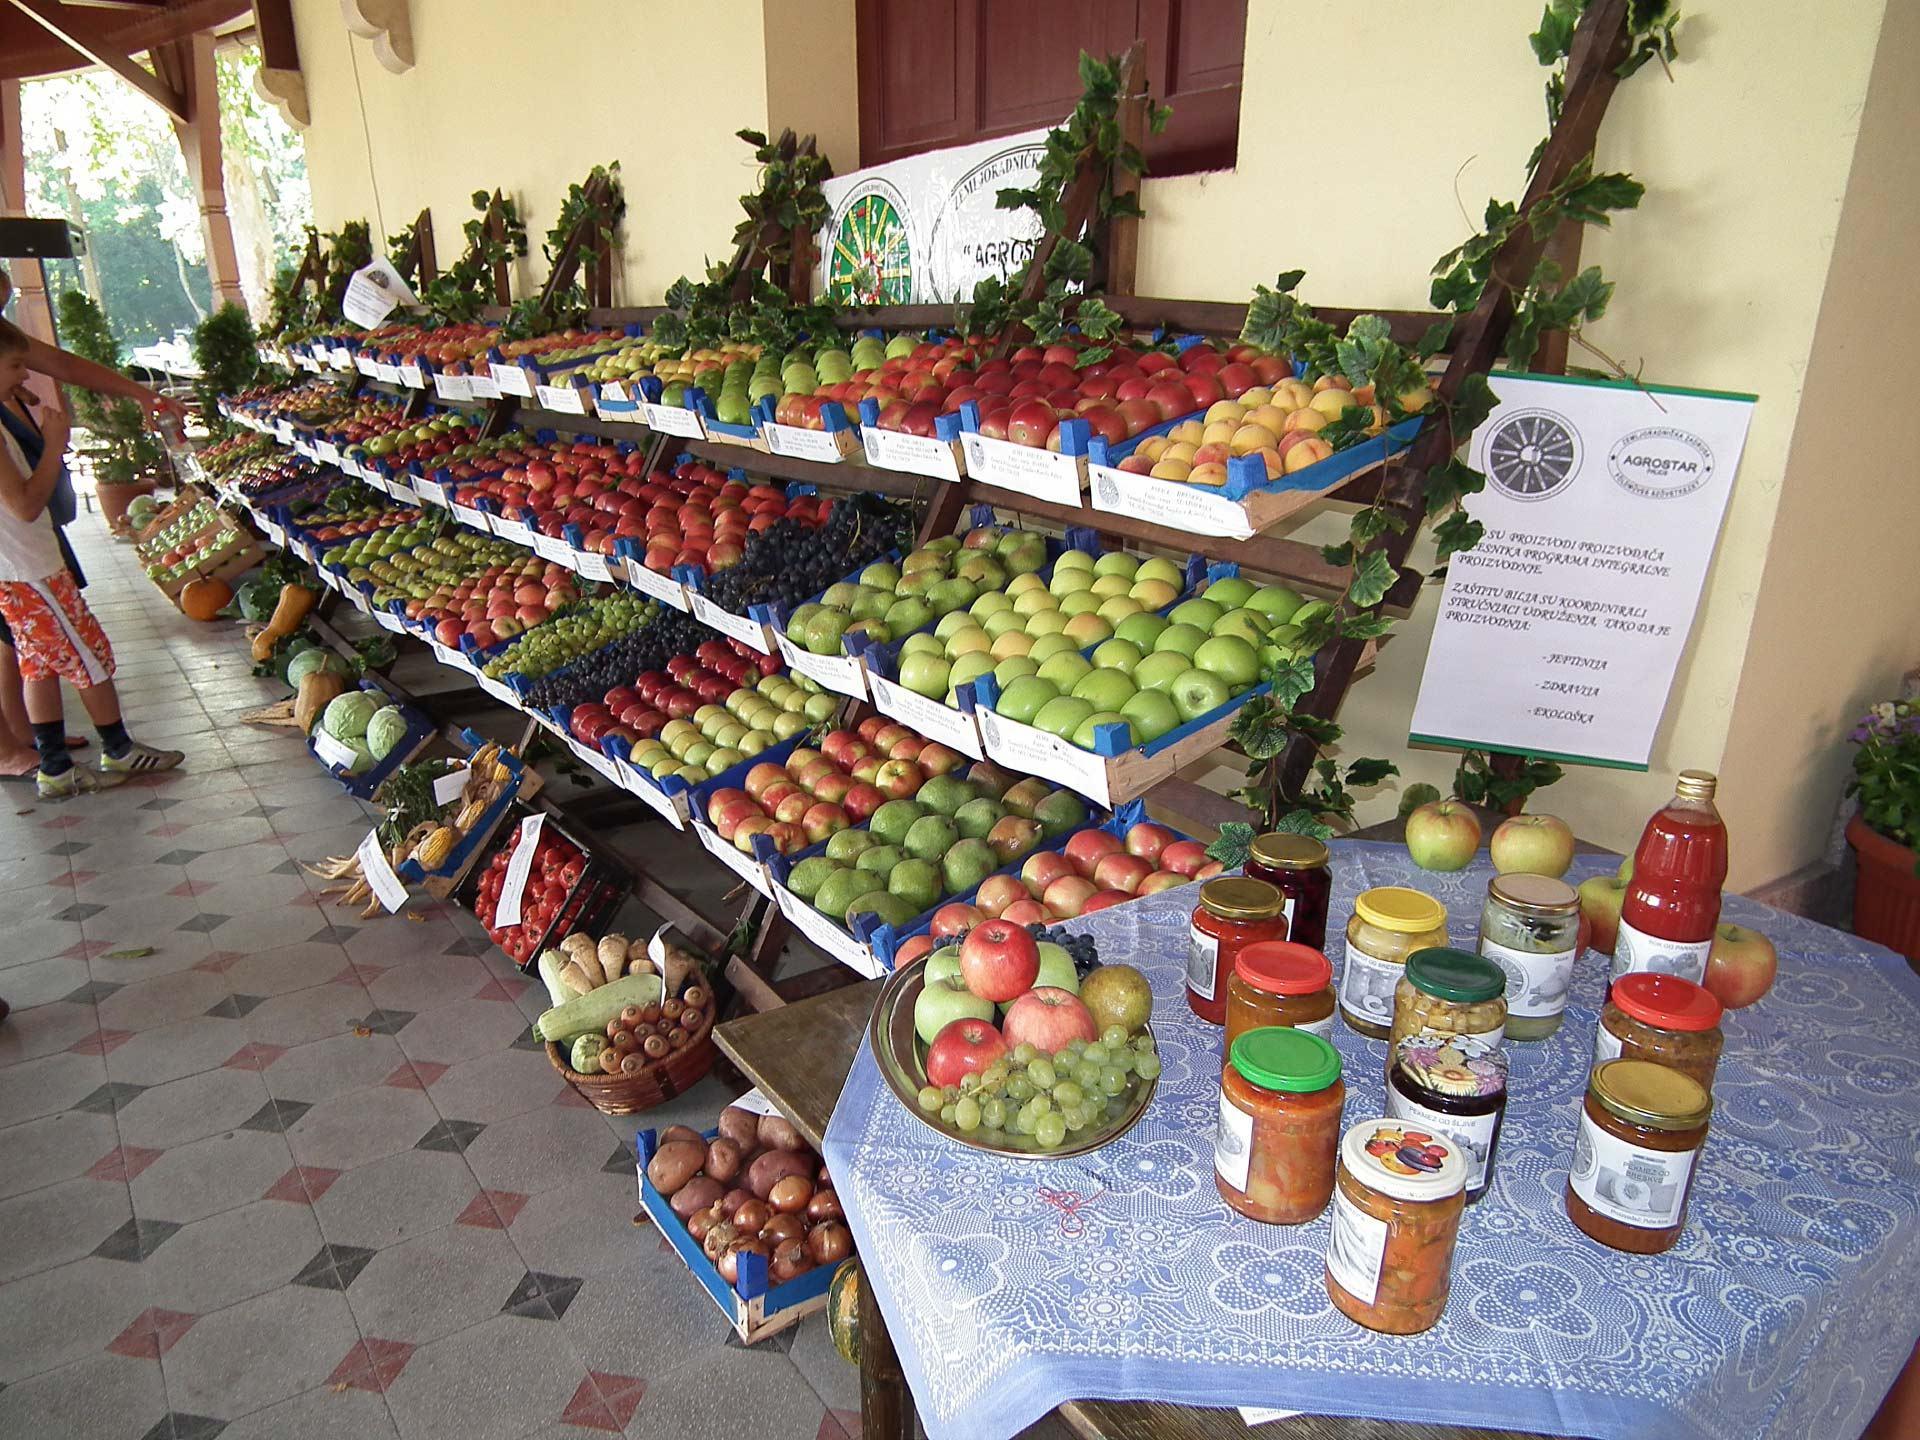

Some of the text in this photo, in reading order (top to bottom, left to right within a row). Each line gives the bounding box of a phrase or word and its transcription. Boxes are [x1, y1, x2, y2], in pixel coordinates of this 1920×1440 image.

[954, 149, 1046, 210] ZEMLJORADNIČK
[1623, 455, 1698, 473] AGROSTAR
[1487, 529, 1506, 541] SU
[1509, 532, 1577, 550] PROIZVODI
[1579, 541, 1665, 562] PROIZVODAČA
[1522, 549, 1589, 568] PROGRAMA
[1591, 558, 1672, 577] INTEGRALNE
[1452, 582, 1503, 598] ZAŠTITU
[1504, 589, 1539, 604] BILJA
[1540, 595, 1559, 606] SU
[1448, 596, 1521, 616] STRUČNJACI
[1604, 617, 1637, 633] TAKO
[1637, 622, 1655, 635] DA
[1655, 625, 1672, 637] JE
[1438, 1118, 1451, 1126] OD
